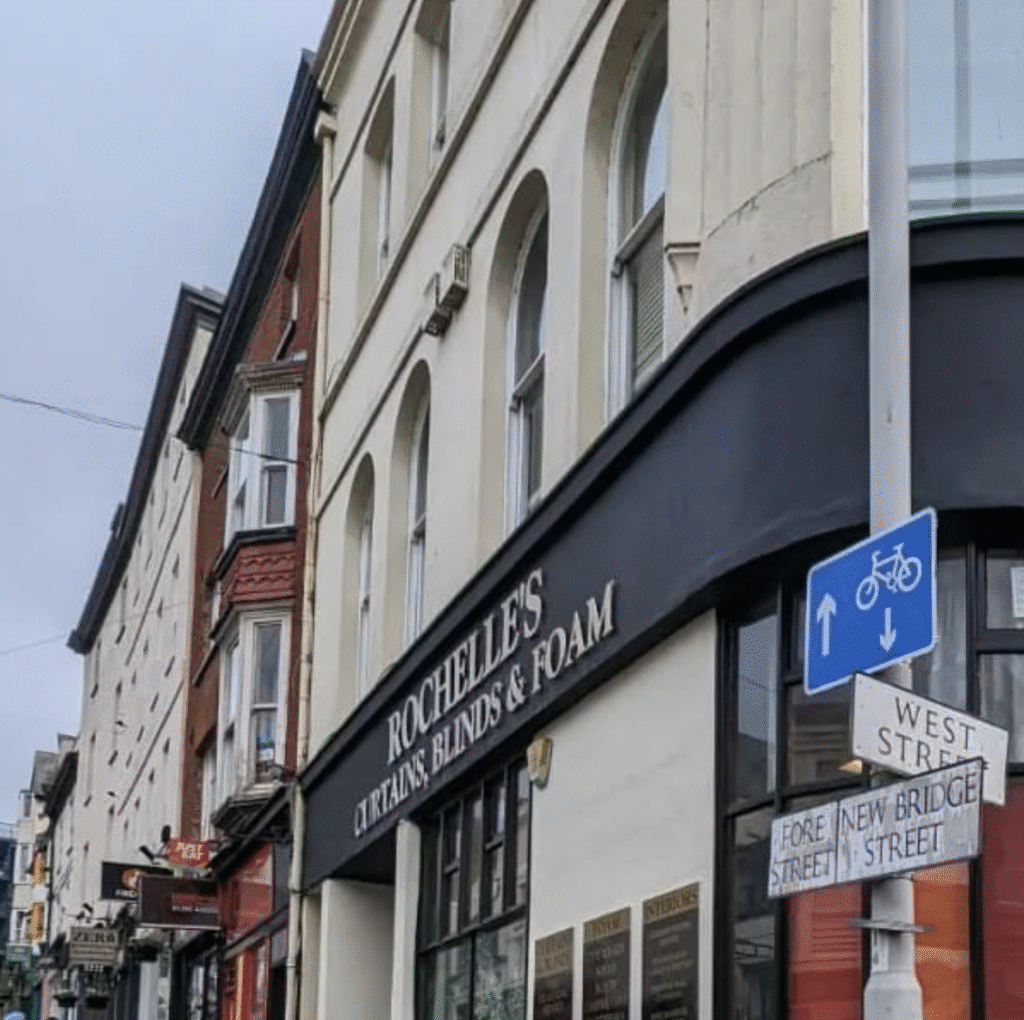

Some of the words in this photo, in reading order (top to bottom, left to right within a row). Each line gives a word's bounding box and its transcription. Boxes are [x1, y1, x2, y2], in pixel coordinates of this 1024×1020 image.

[386, 567, 543, 766] ROCHELLE'S
[354, 749, 430, 837] CURTAINS,
[432, 680, 503, 776] BLINDS
[504, 663, 526, 713] &
[531, 579, 616, 695] FOAM
[894, 696, 977, 752] WEST
[841, 797, 889, 832] NEW
[895, 772, 978, 822] BRIDGE
[782, 815, 825, 850] FORE
[864, 821, 944, 867] STREET
[770, 848, 836, 887] STREET
